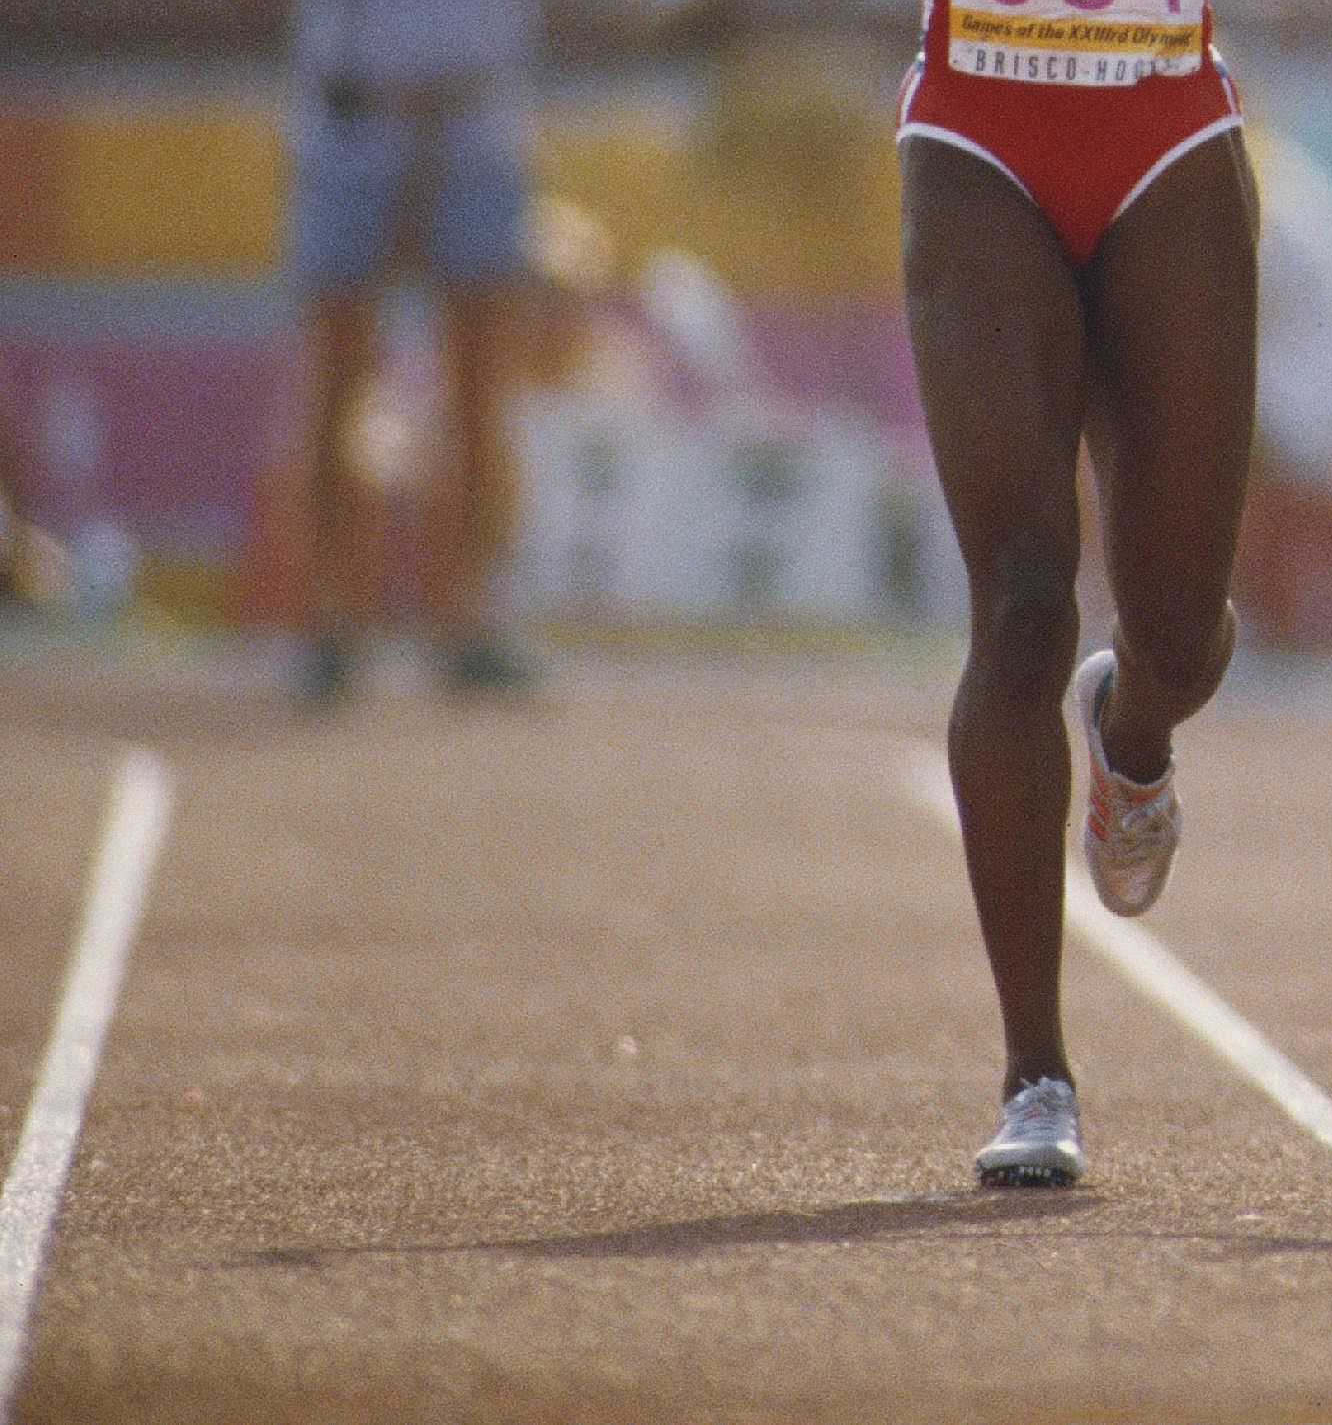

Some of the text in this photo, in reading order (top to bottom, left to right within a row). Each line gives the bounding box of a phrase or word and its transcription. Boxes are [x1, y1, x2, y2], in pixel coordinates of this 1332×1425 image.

[961, 14, 1013, 37] Games
[1016, 23, 1036, 39] of
[1038, 23, 1064, 40] the
